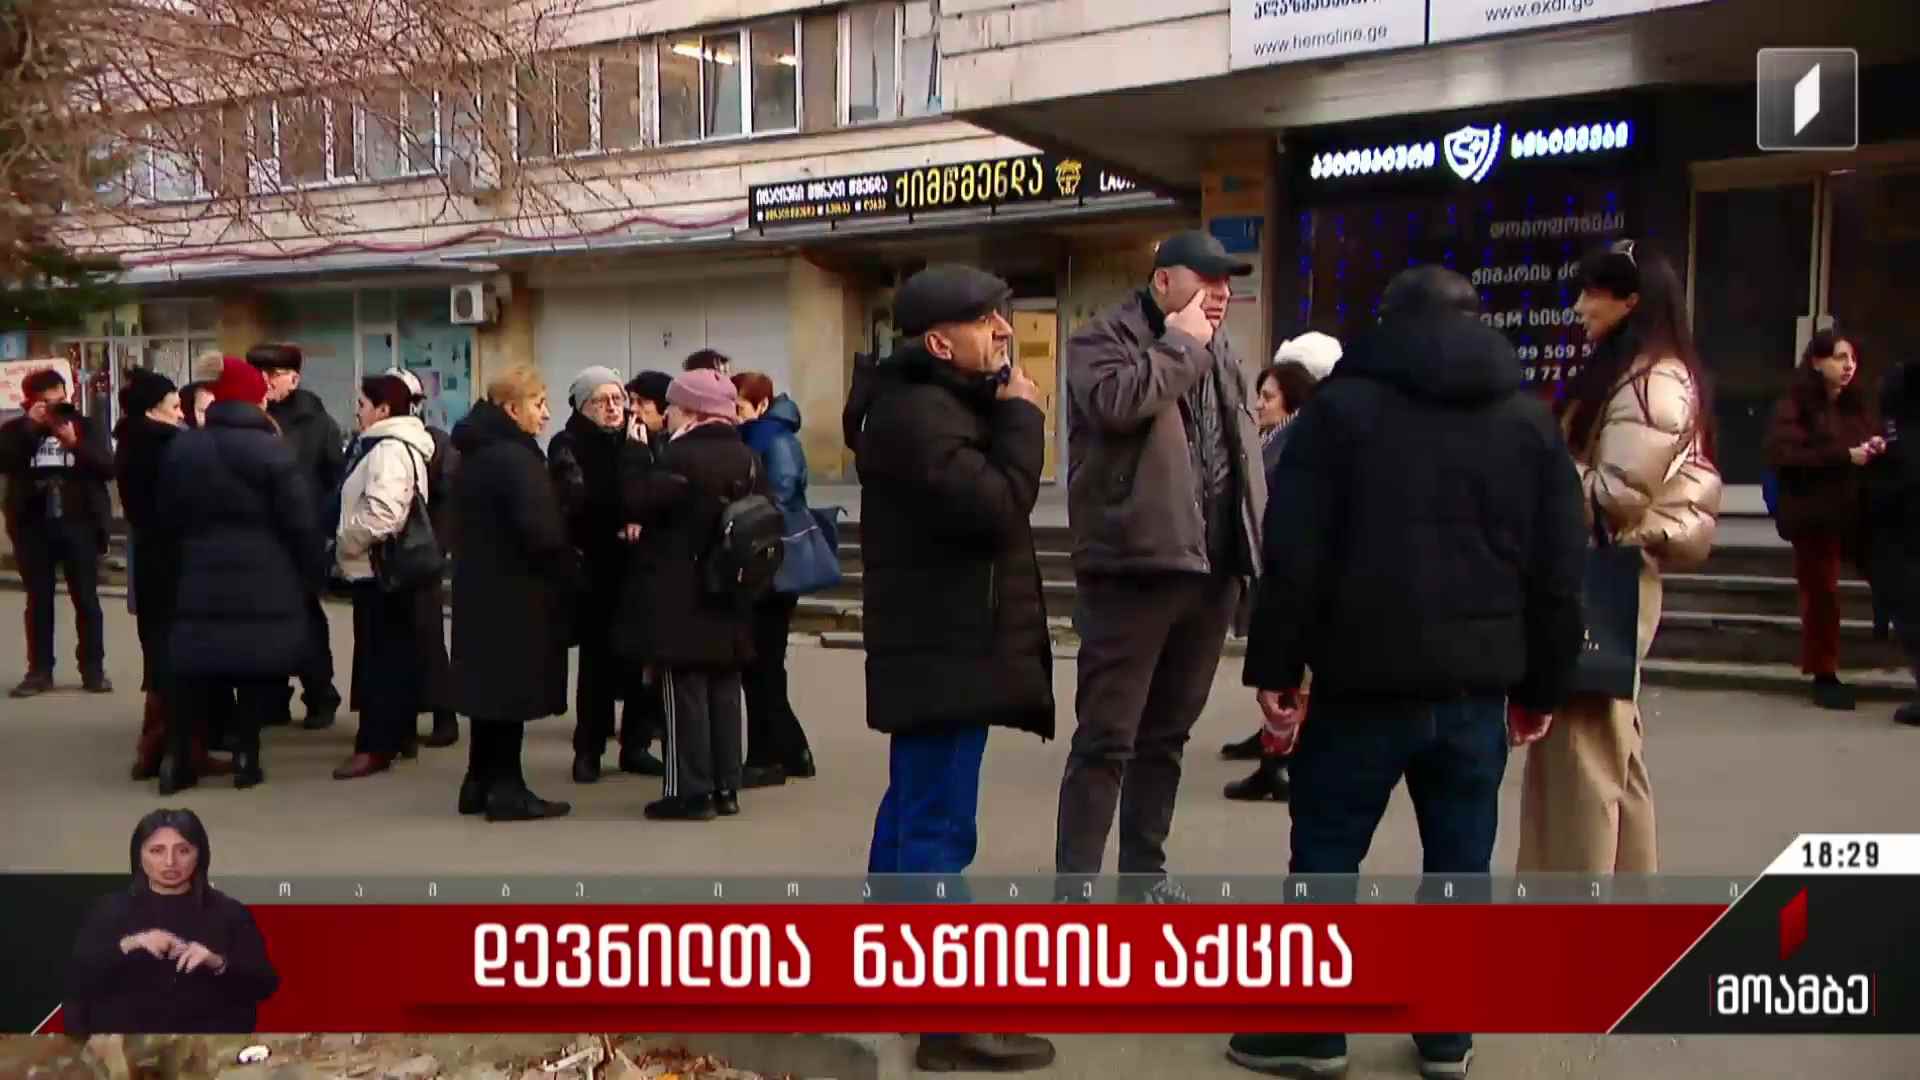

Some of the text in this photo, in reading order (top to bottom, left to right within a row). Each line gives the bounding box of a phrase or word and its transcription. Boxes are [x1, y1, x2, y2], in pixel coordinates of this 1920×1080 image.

[1254, 24, 1388, 56] www.hemoline.ge
[895, 157, 1044, 208] ქიმწმენდა
[1516, 344, 1539, 360] 99
